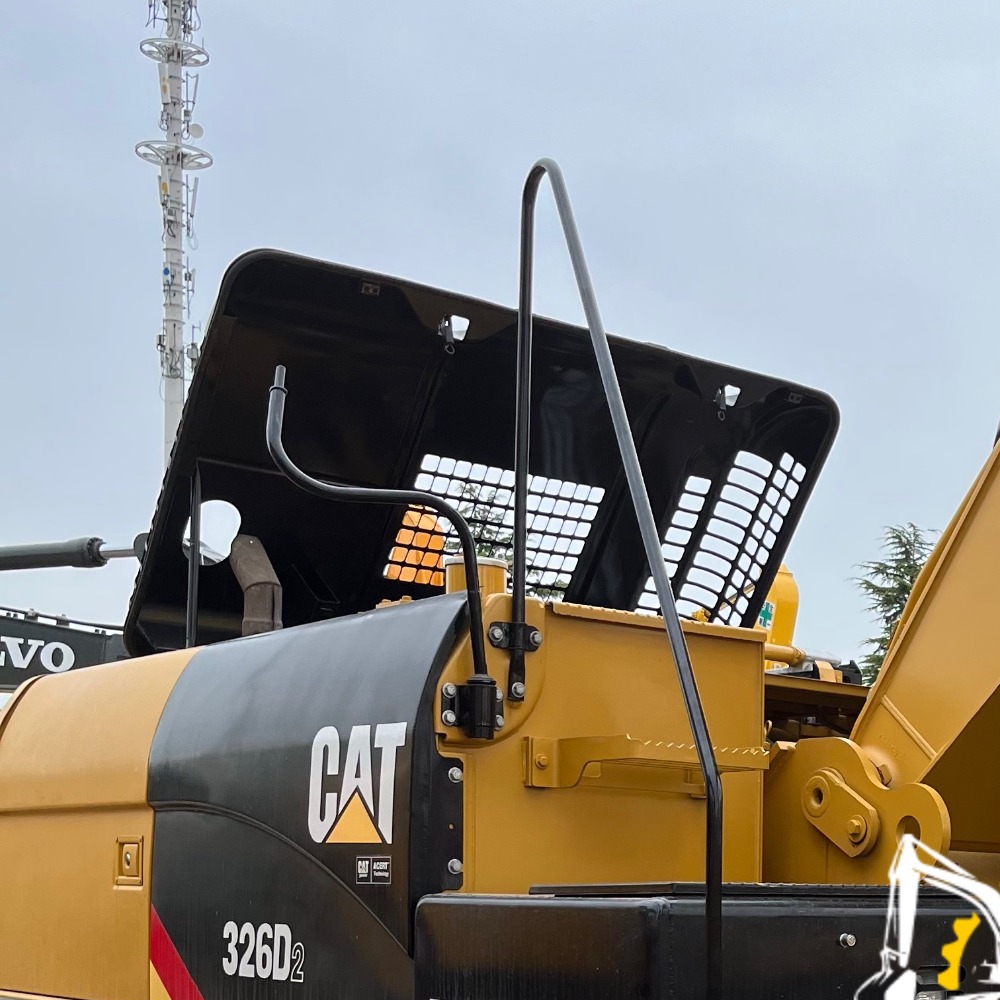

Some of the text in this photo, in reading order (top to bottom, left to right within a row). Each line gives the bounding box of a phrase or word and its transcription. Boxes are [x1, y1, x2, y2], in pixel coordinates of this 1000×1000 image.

[0, 636, 75, 673] VO
[308, 721, 408, 844] CAT
[222, 920, 305, 983] 326D2
